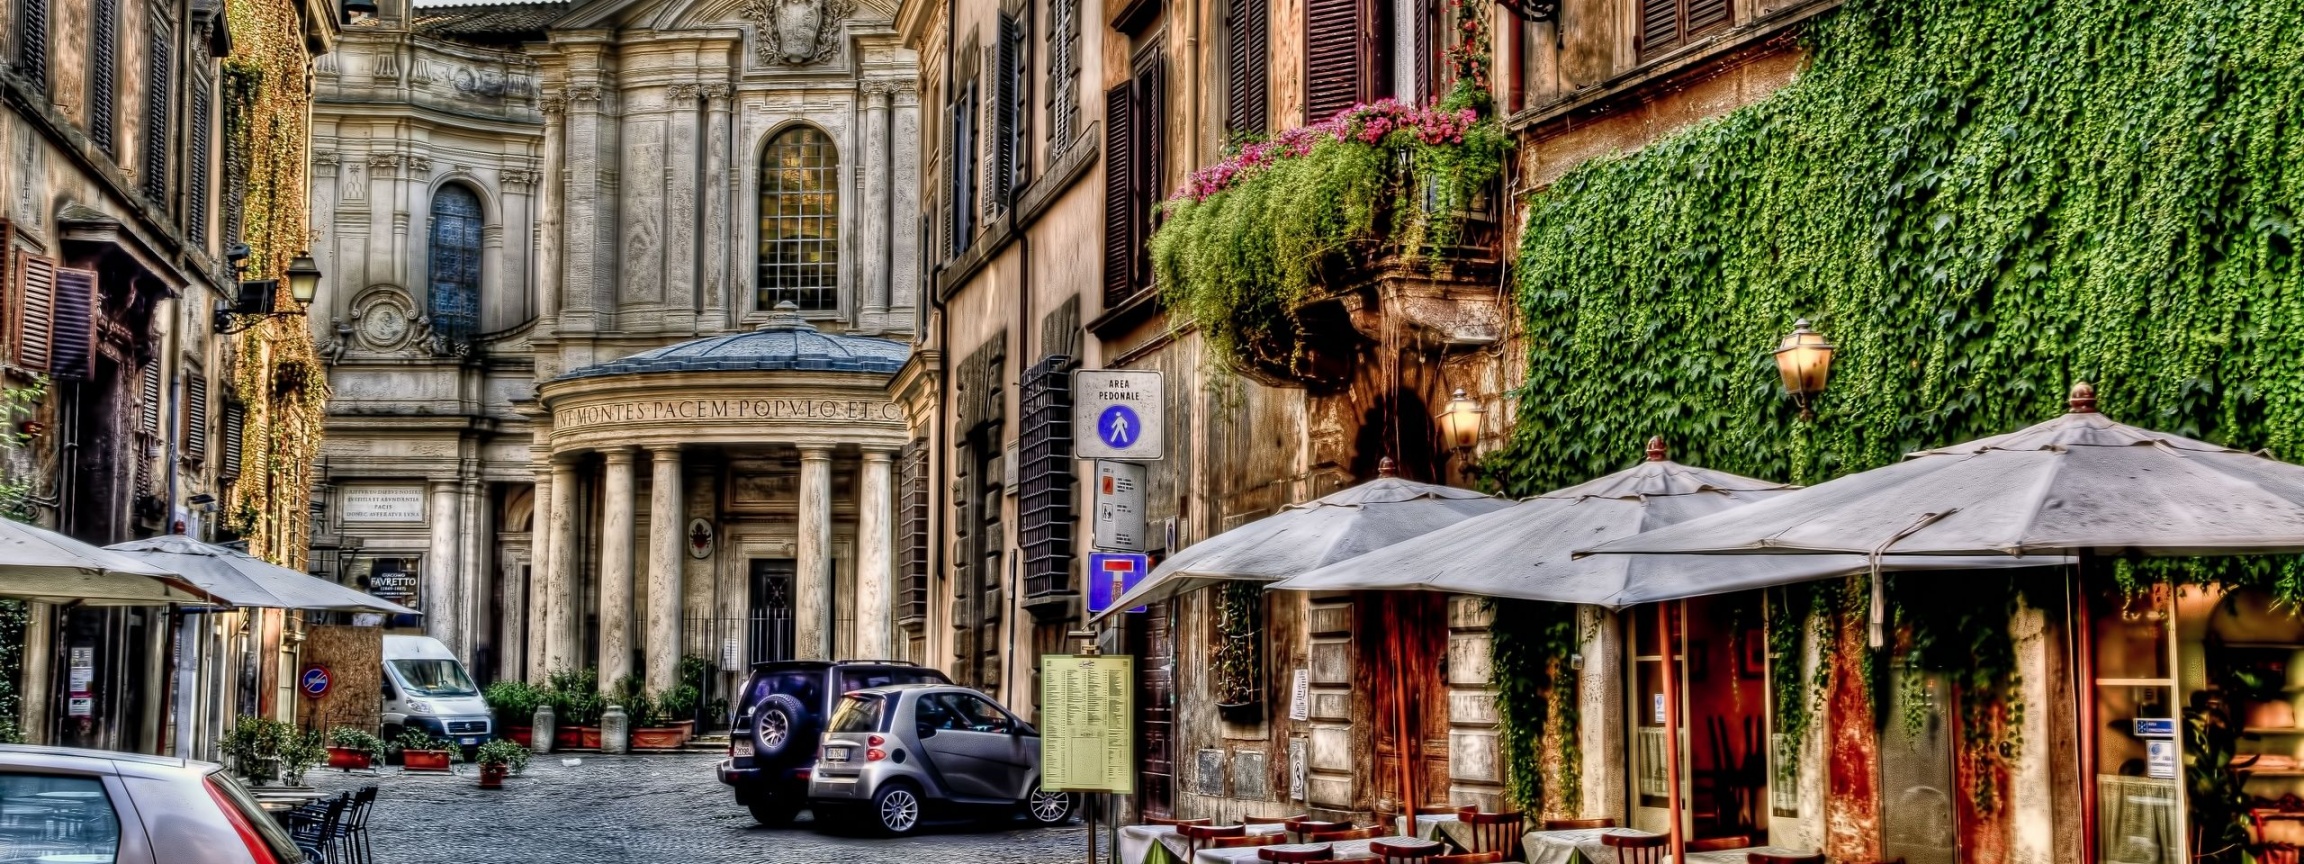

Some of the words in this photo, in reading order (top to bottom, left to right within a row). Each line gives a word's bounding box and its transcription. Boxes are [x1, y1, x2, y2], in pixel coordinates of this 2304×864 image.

[1108, 379, 1130, 389] AREA
[1099, 391, 1140, 401] PEDONALE
[577, 402, 645, 425] MONTES
[654, 400, 728, 419] PACEM
[739, 400, 836, 418] POPVLO
[849, 401, 873, 419] ET
[370, 577, 417, 587] FAVRETTO
